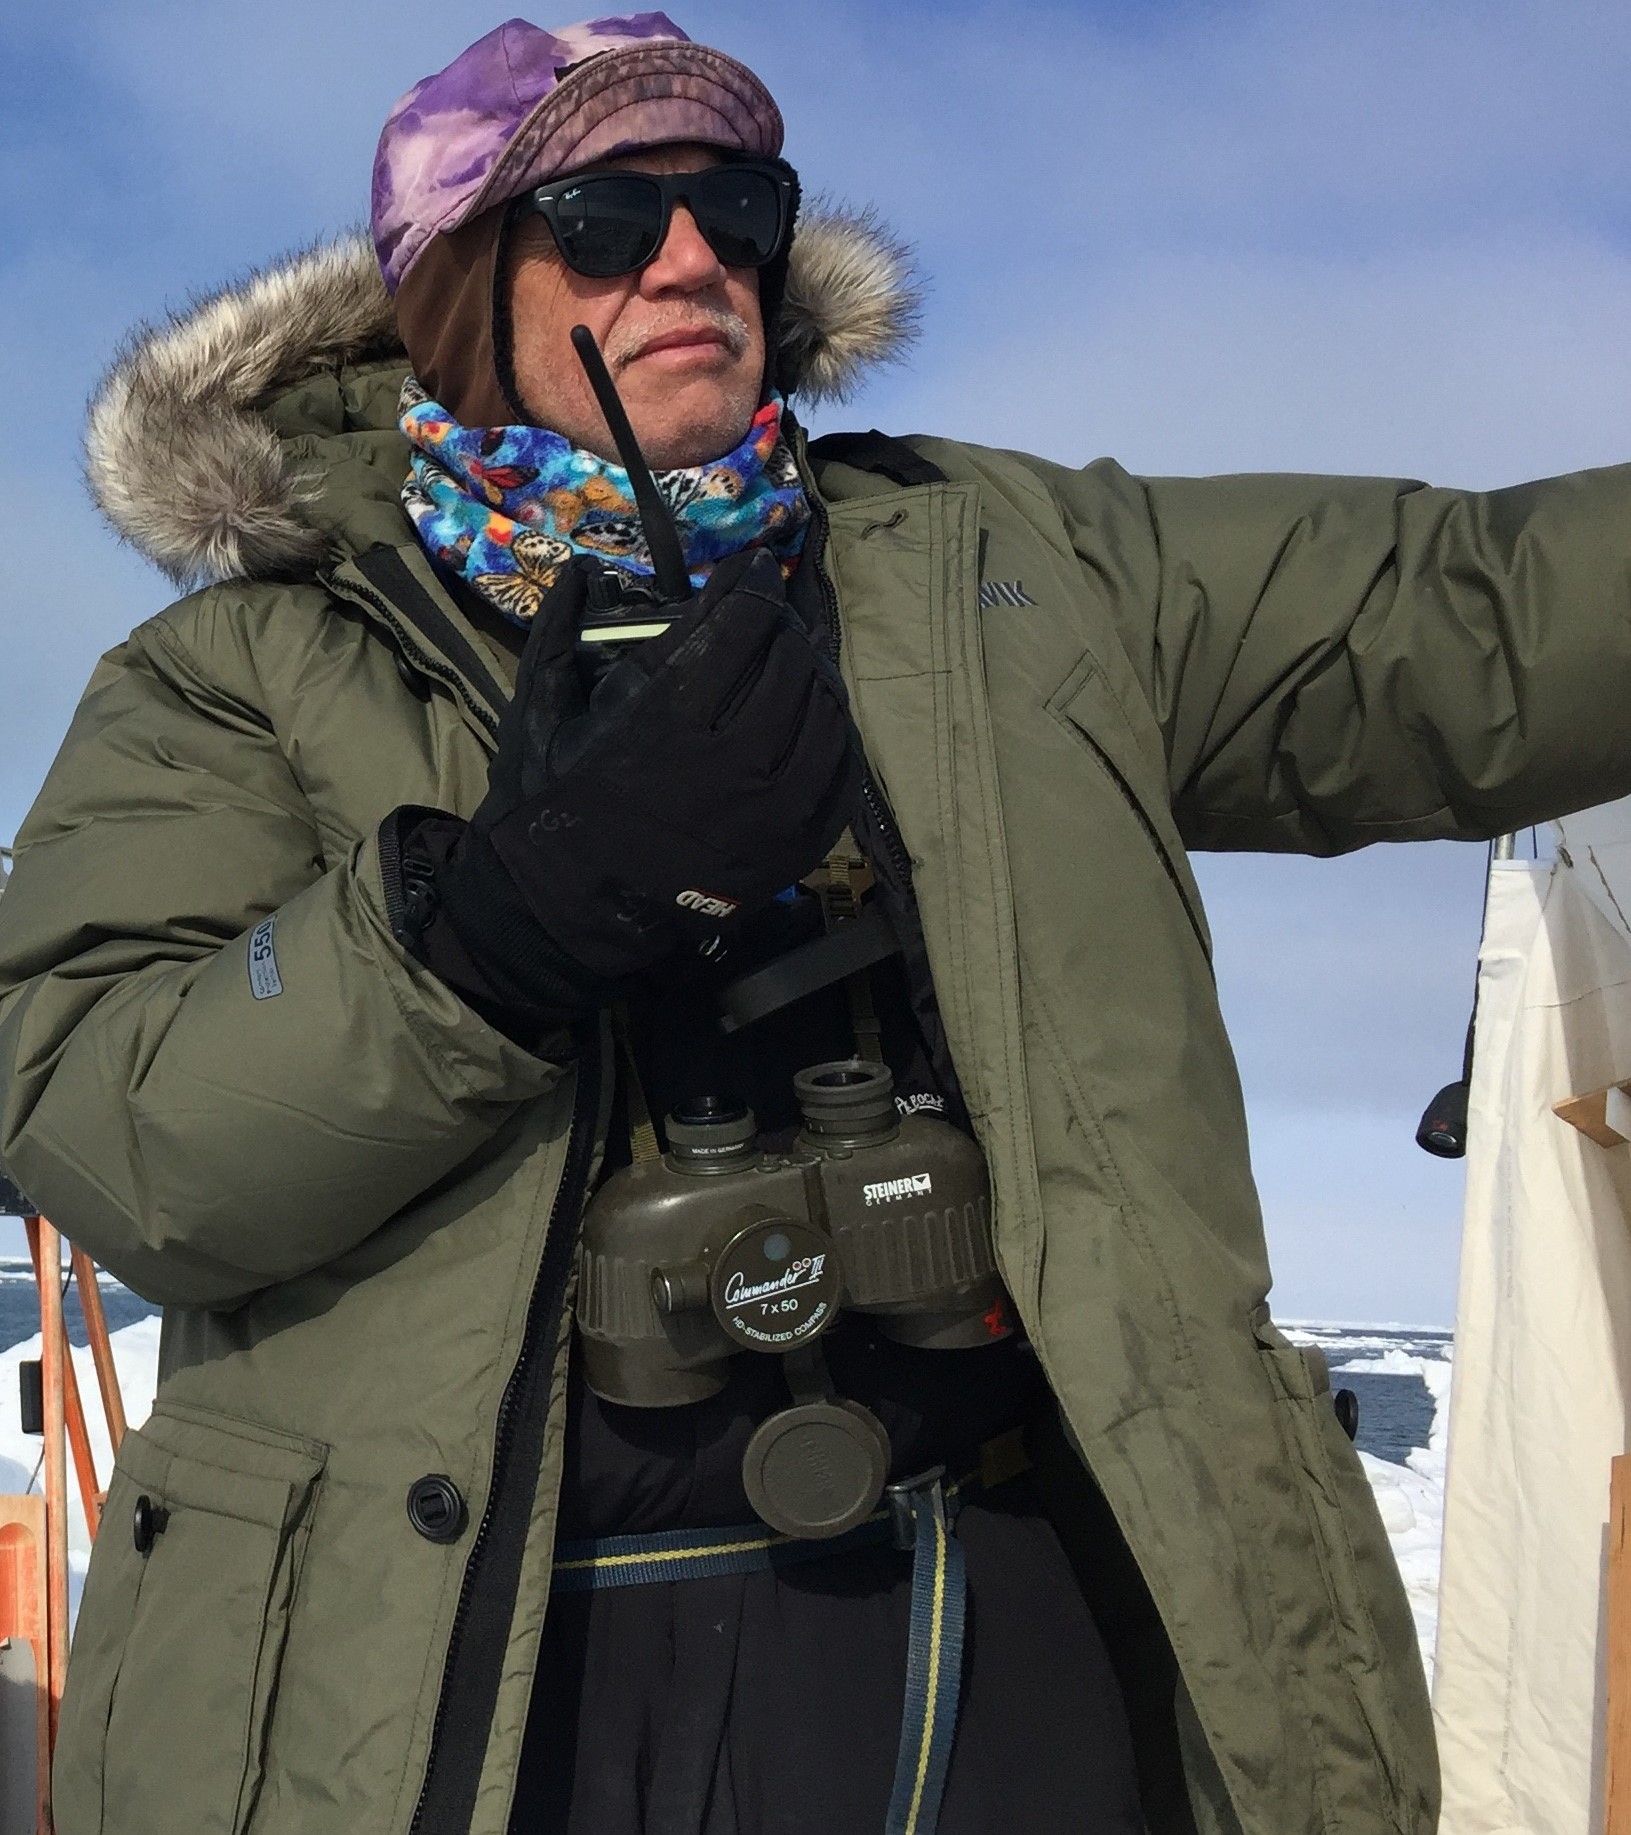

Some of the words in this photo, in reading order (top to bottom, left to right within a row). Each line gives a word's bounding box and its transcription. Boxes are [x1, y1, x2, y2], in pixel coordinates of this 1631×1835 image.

[676, 889, 737, 918] HEAD
[254, 921, 272, 962] 550
[863, 1177, 914, 1201] STEINER
[725, 1267, 807, 1304] Commander
[732, 1315, 794, 1342] HD-STABILIZED
[794, 1301, 828, 1337] COMPASS
